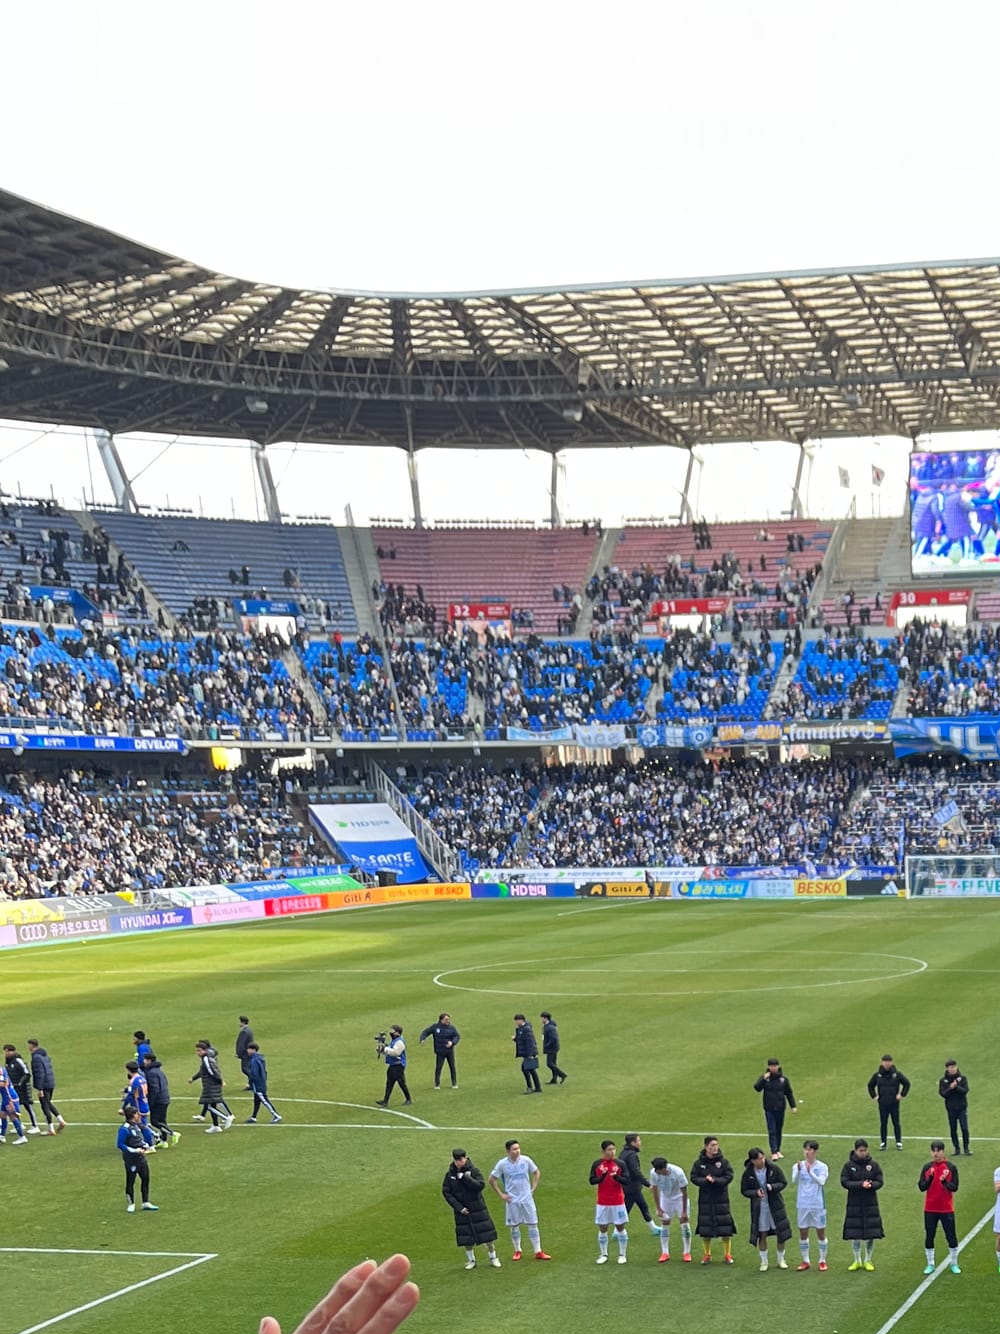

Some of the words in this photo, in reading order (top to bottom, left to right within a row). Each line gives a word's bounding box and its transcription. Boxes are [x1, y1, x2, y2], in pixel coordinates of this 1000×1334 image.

[899, 592, 916, 604] 30
[240, 600, 248, 612] 1
[454, 605, 470, 617] 32
[661, 601, 677, 613] 31
[134, 738, 179, 750] DEVELON
[434, 886, 464, 896] BESKO
[611, 886, 632, 894] Giti
[797, 881, 842, 895] BESKO
[66, 897, 112, 911] SIEG
[343, 894, 362, 904] Giti
[120, 913, 161, 929] HYUNDAI
[50, 918, 107, 937] 유카로오토모빌
